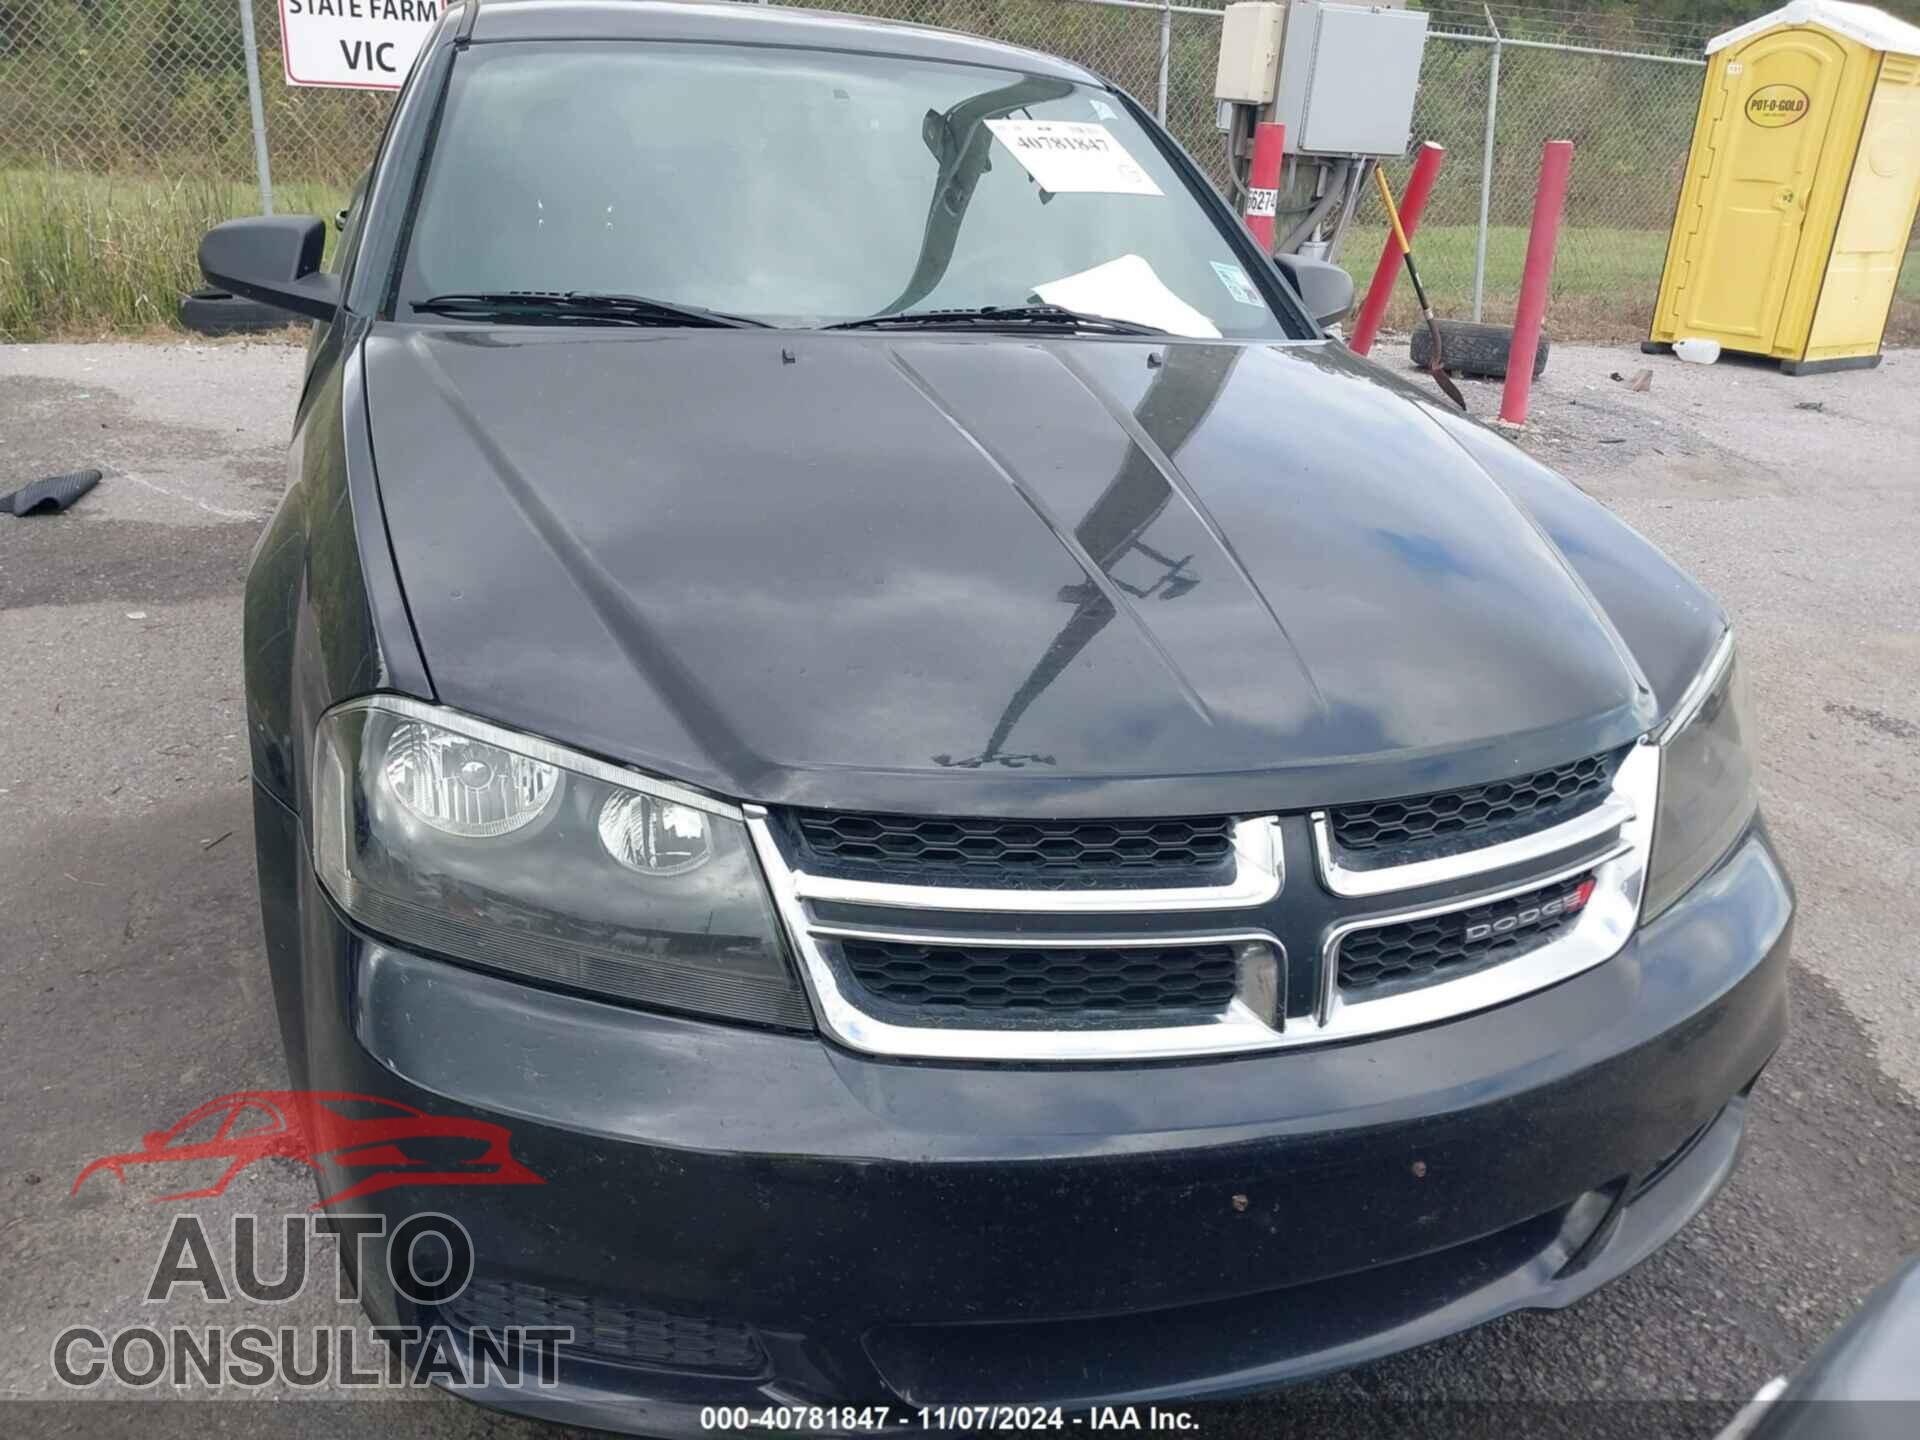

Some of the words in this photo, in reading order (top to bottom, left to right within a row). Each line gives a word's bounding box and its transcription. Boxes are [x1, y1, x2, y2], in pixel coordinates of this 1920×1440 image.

[289, 0, 363, 18] STATE
[370, 0, 438, 22] FARM
[339, 39, 397, 73] VIC
[1017, 136, 1110, 152] 40781847
[1465, 890, 1583, 944] DODGE
